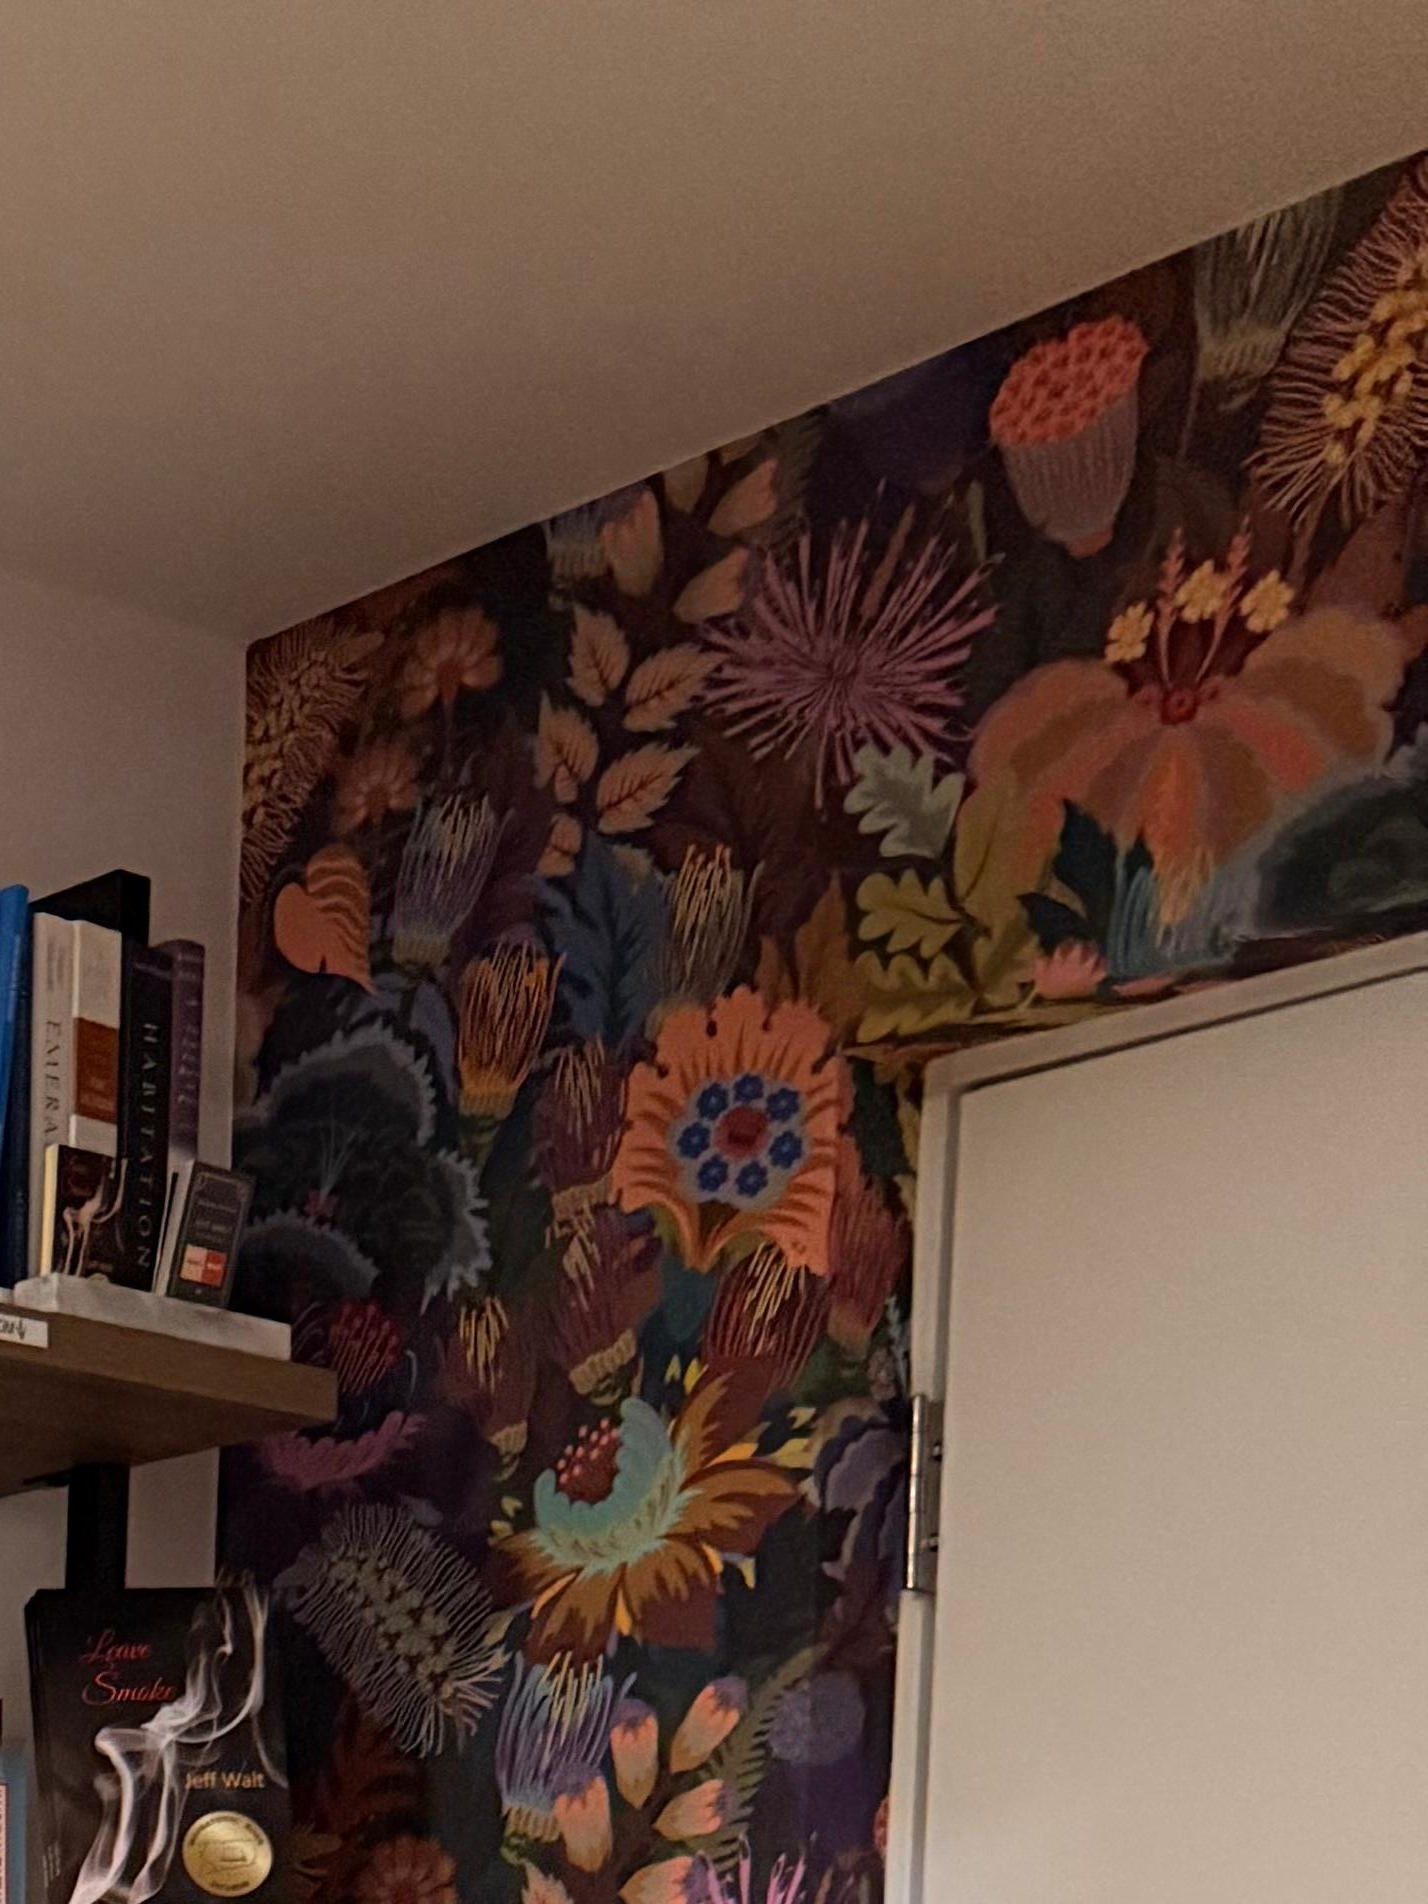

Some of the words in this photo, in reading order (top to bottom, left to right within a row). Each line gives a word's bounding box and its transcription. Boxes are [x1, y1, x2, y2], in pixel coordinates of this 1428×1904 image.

[135, 1023, 160, 1270] HABITATION
[82, 1672, 176, 1705] Smoke
[185, 1771, 217, 1790] Jeff
[221, 1771, 265, 1789] Walt
